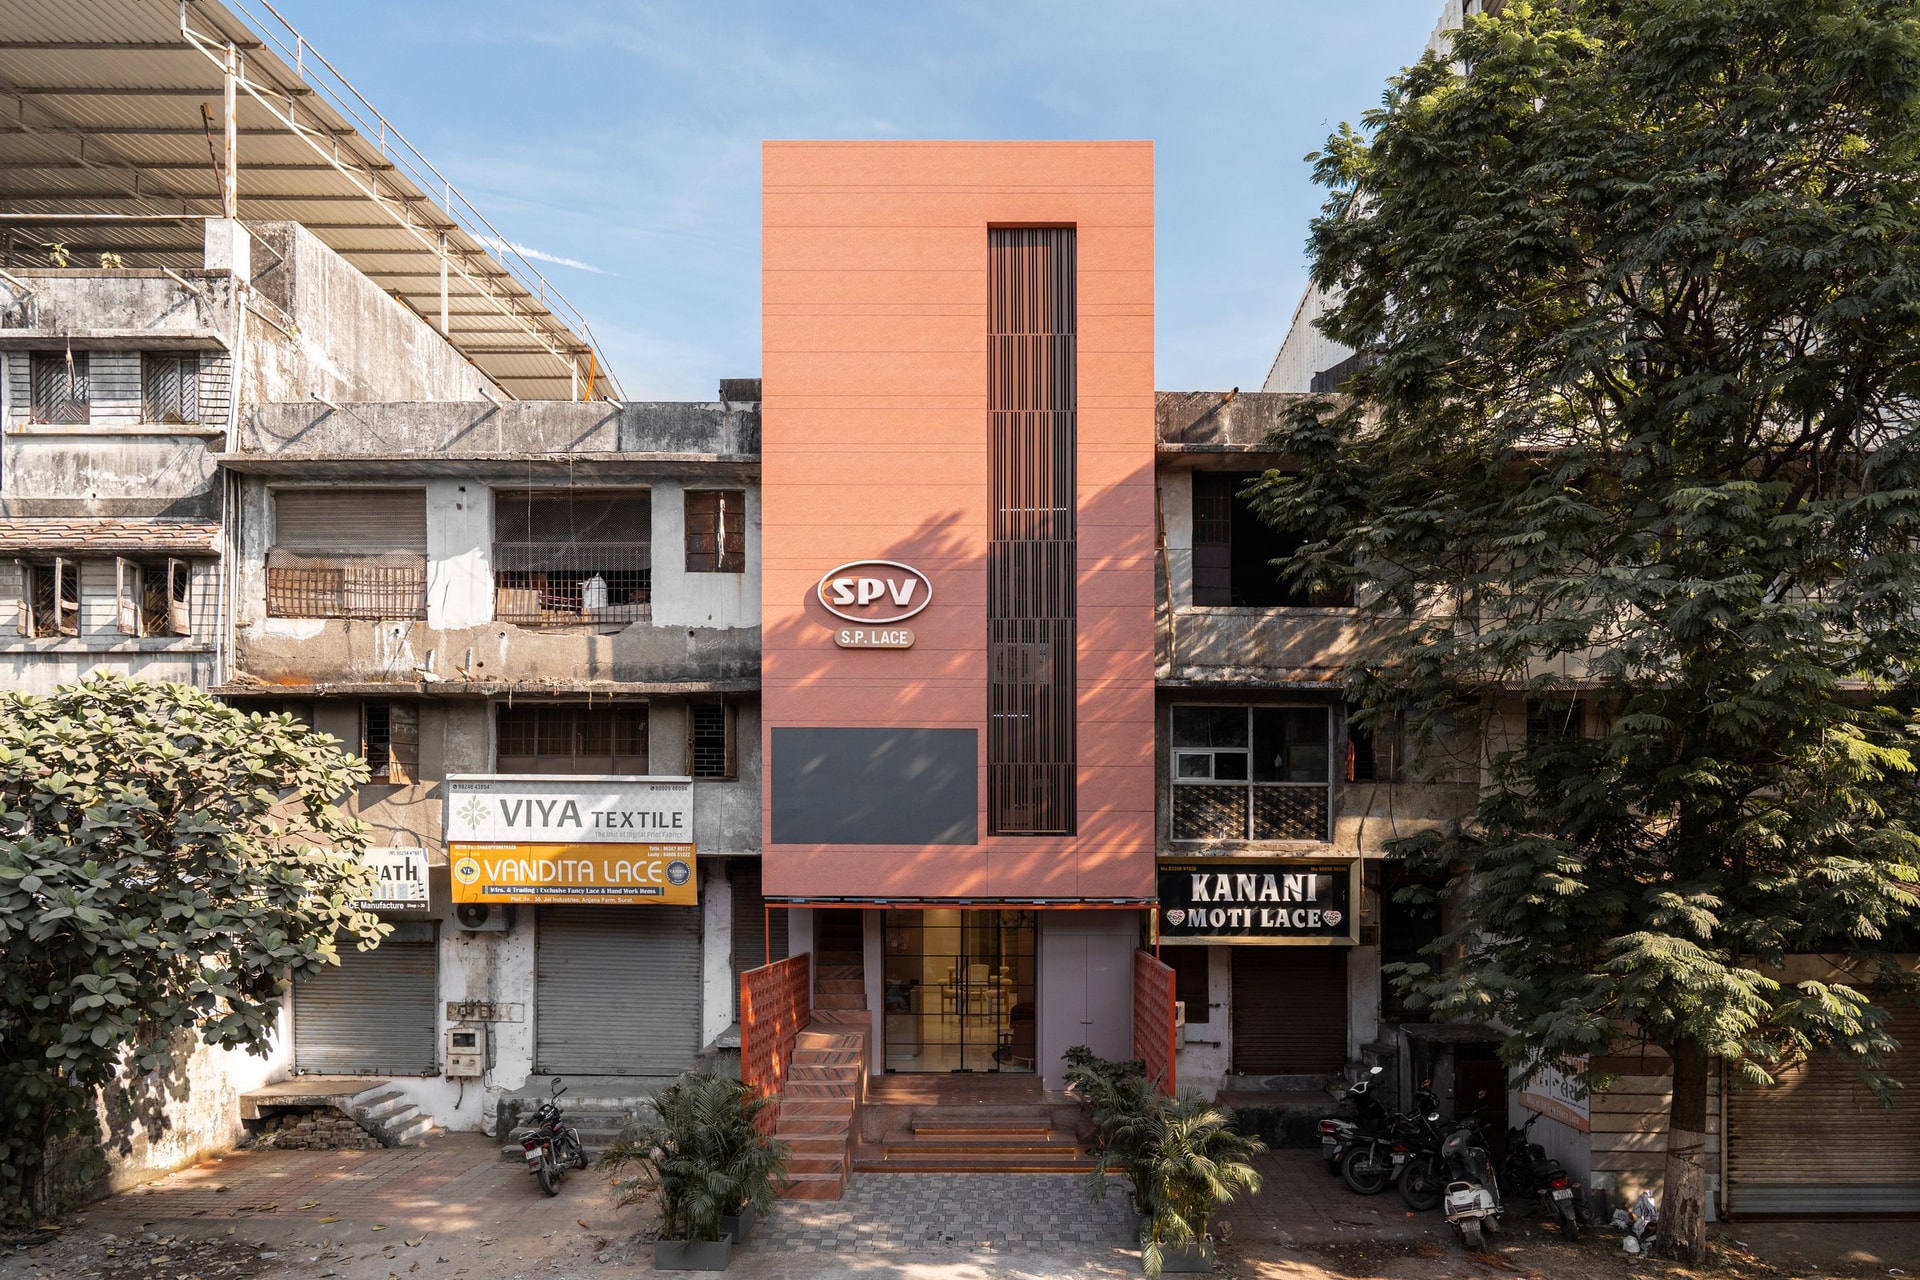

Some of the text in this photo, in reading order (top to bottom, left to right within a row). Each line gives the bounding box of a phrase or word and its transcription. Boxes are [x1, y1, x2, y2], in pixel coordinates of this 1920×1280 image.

[831, 578, 918, 606] SPV
[841, 630, 908, 644] S.P. LACE
[499, 799, 683, 829] VIYA TEXTILE
[626, 831, 646, 839] Digital
[483, 859, 663, 883] VANDITA LACE
[1190, 873, 1317, 902] KANANI
[361, 901, 404, 910] Manufacture
[1187, 908, 1321, 928] MOTI LACE
